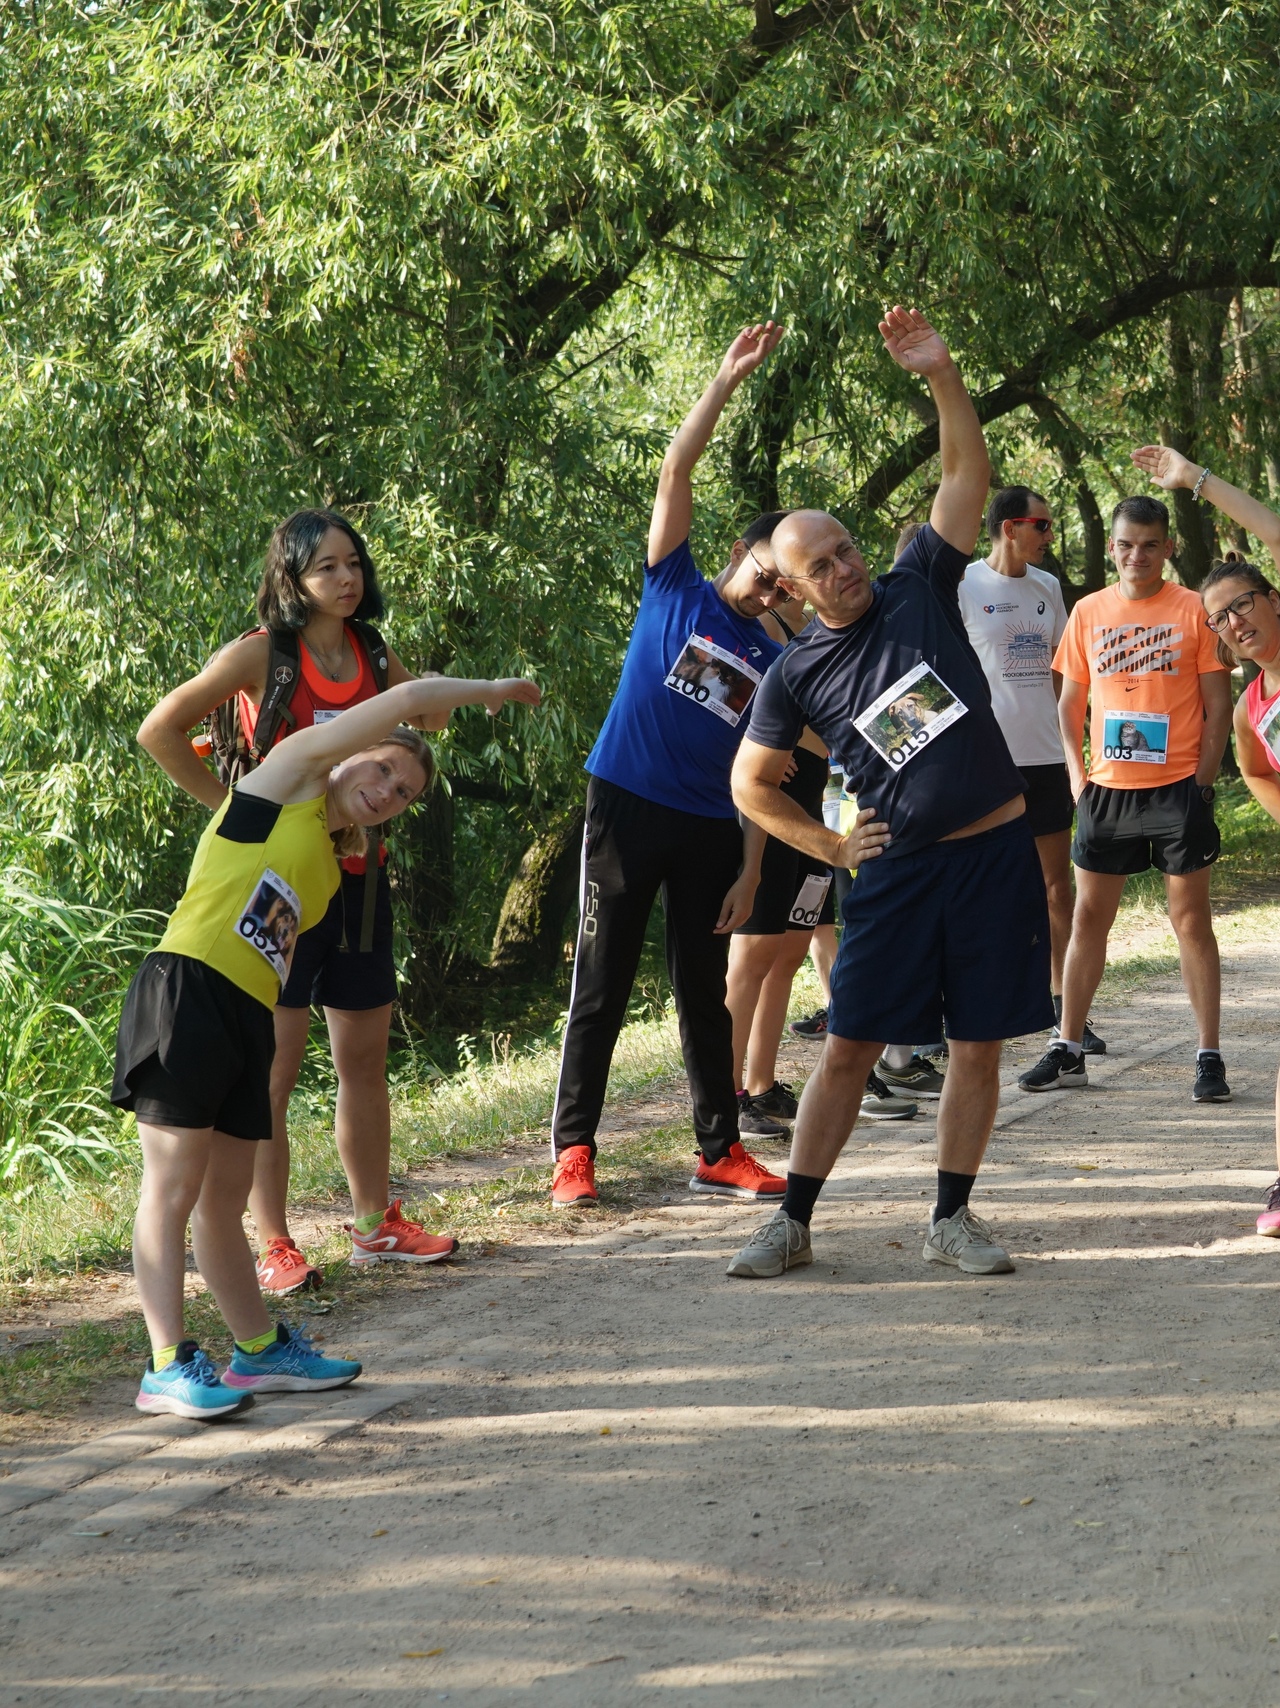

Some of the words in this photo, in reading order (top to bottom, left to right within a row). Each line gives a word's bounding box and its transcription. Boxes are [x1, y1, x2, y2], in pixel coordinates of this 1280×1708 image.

[1102, 626, 1128, 650] WE
[1134, 625, 1173, 648] RUN
[1097, 649, 1174, 674] SUMMER
[668, 673, 711, 703] 100
[888, 723, 930, 765] 015
[1104, 745, 1133, 760] 003
[583, 880, 599, 936] F50
[240, 916, 281, 963] 052
